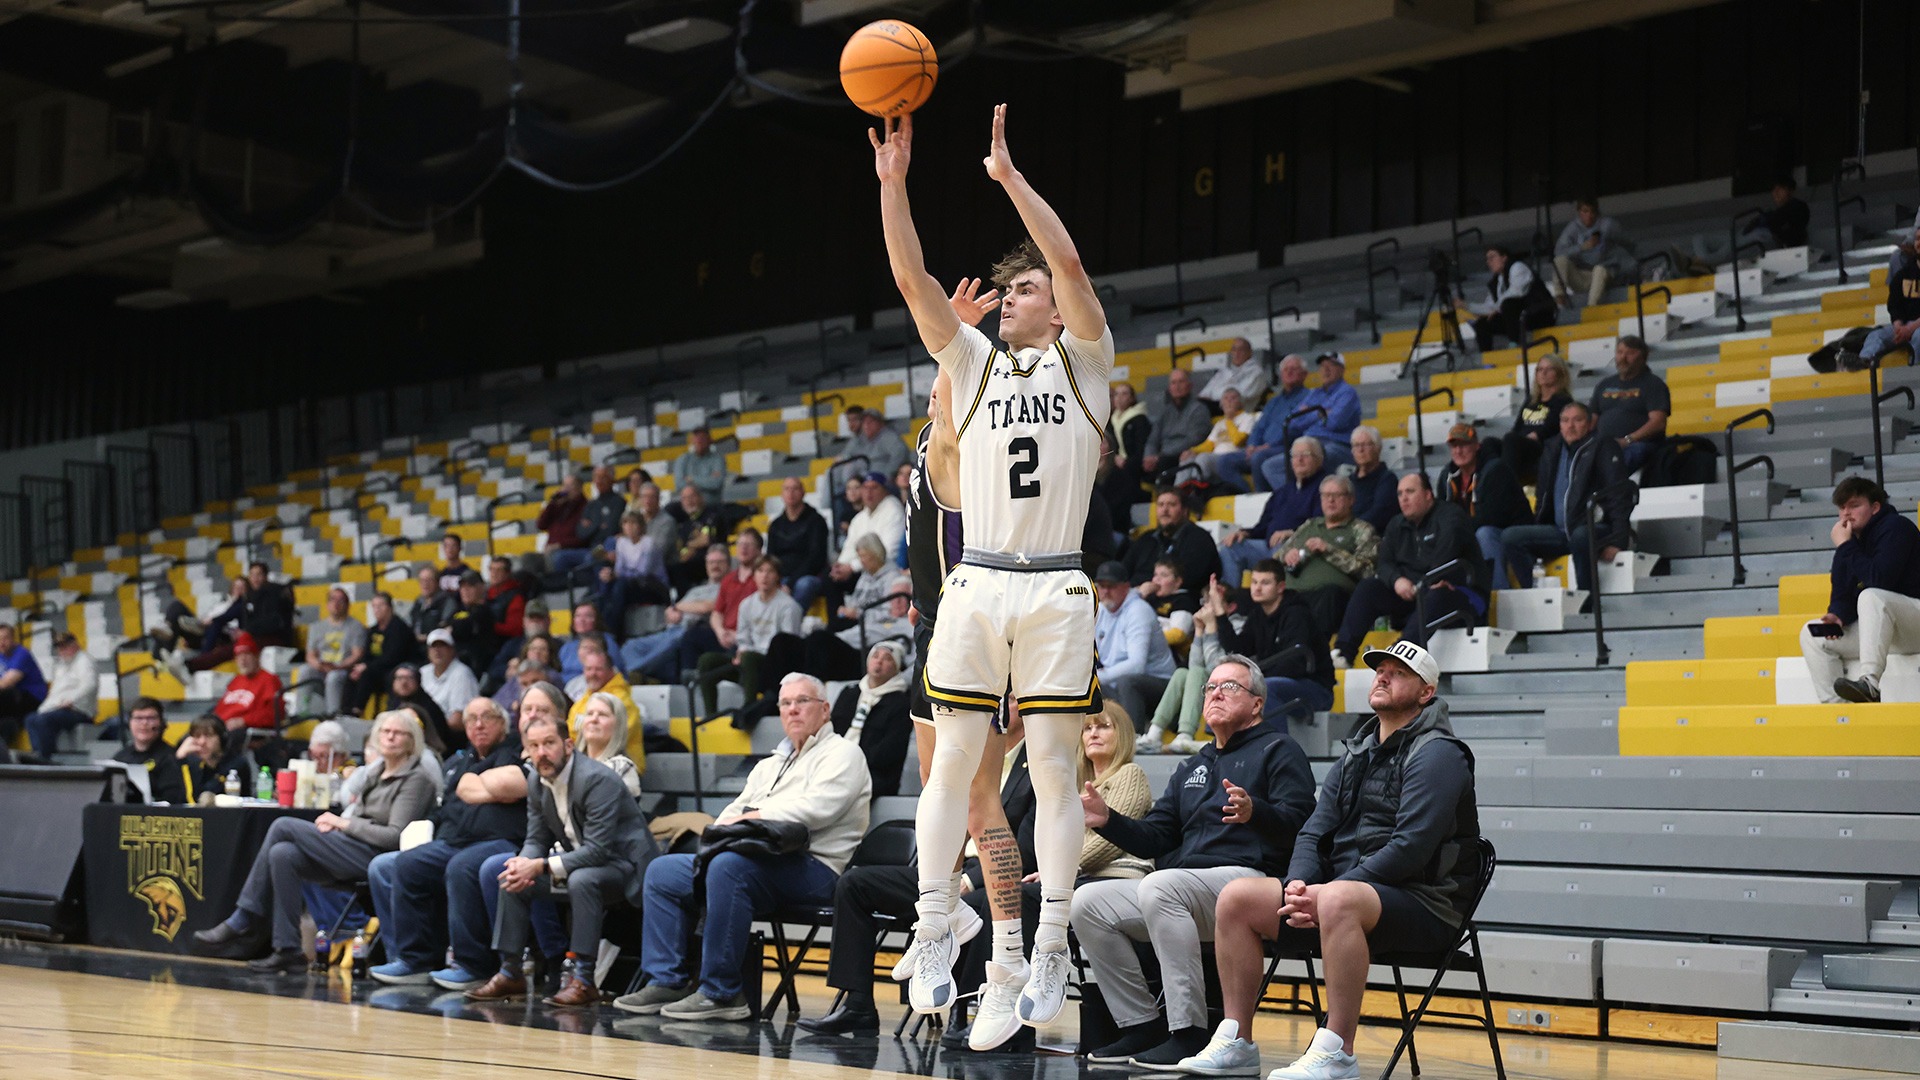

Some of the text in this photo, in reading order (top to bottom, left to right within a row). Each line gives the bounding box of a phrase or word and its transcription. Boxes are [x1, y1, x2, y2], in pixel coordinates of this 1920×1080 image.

[1194, 166, 1214, 197] G
[1265, 151, 1285, 184] H
[1008, 436, 1041, 499] 2
[992, 881, 1014, 890] LORD
